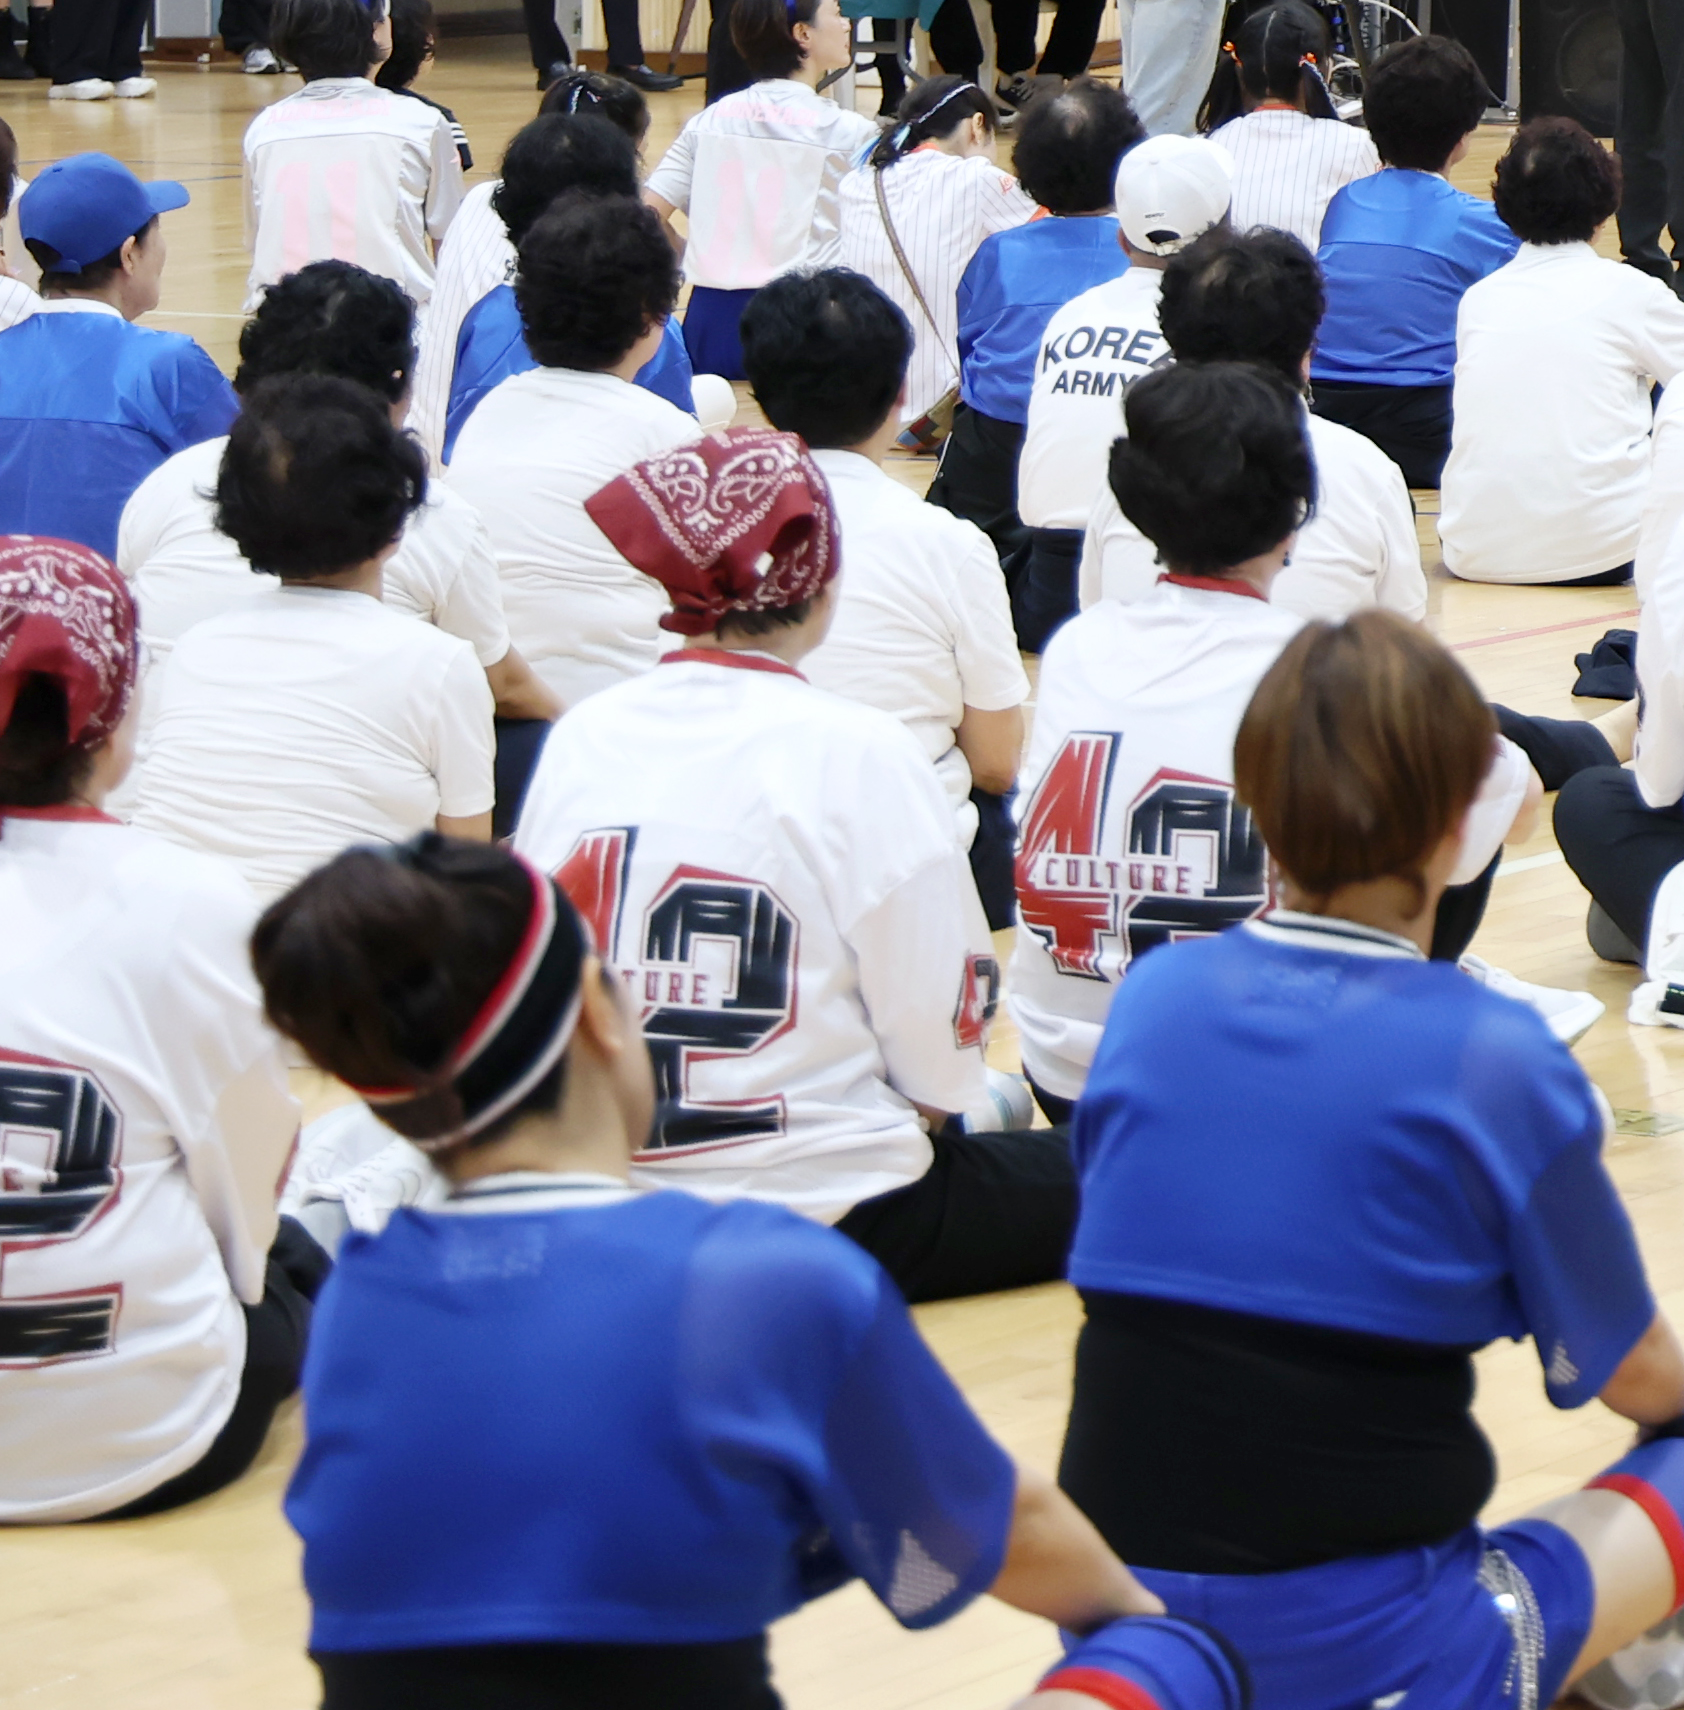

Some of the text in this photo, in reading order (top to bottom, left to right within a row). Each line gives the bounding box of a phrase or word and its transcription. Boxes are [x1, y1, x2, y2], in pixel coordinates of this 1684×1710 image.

[1051, 369, 1141, 397] ARMY
[1046, 858, 1193, 897] CULTURE
[622, 969, 710, 1005] TURE
